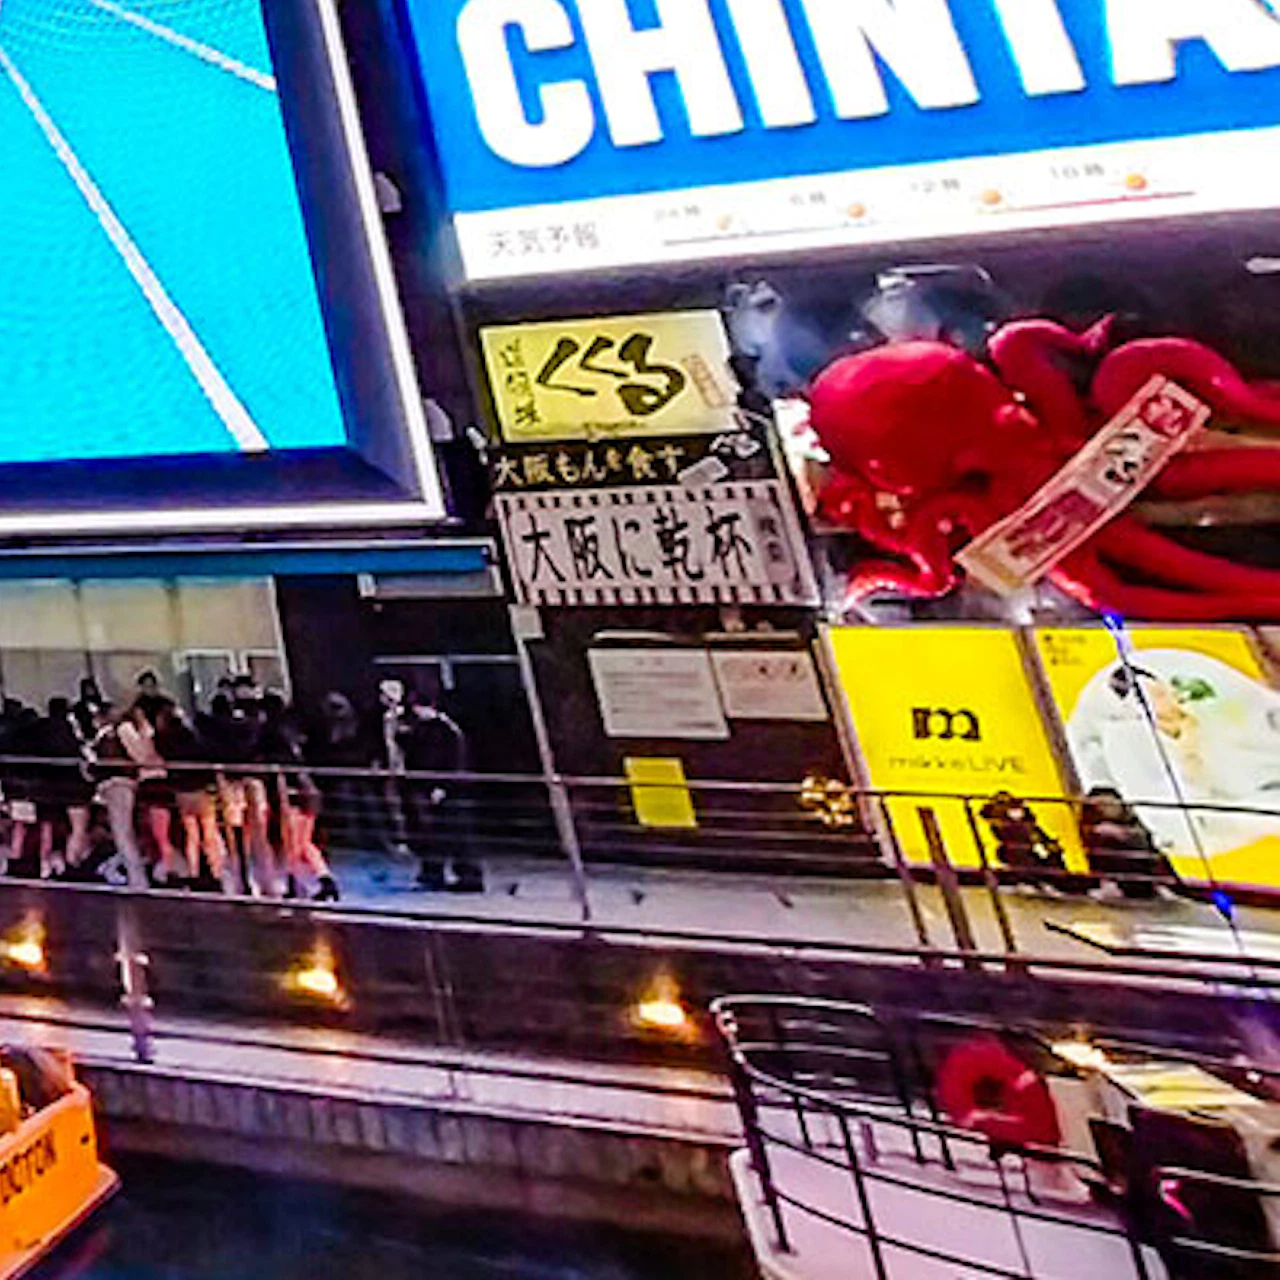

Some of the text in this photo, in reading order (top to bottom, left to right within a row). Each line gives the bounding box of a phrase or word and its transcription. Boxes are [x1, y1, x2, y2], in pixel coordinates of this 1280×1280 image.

[536, 333, 686, 416] くくる
[494, 444, 686, 485] 大阪もんを食す
[522, 506, 752, 582] 大阪に乾杯
